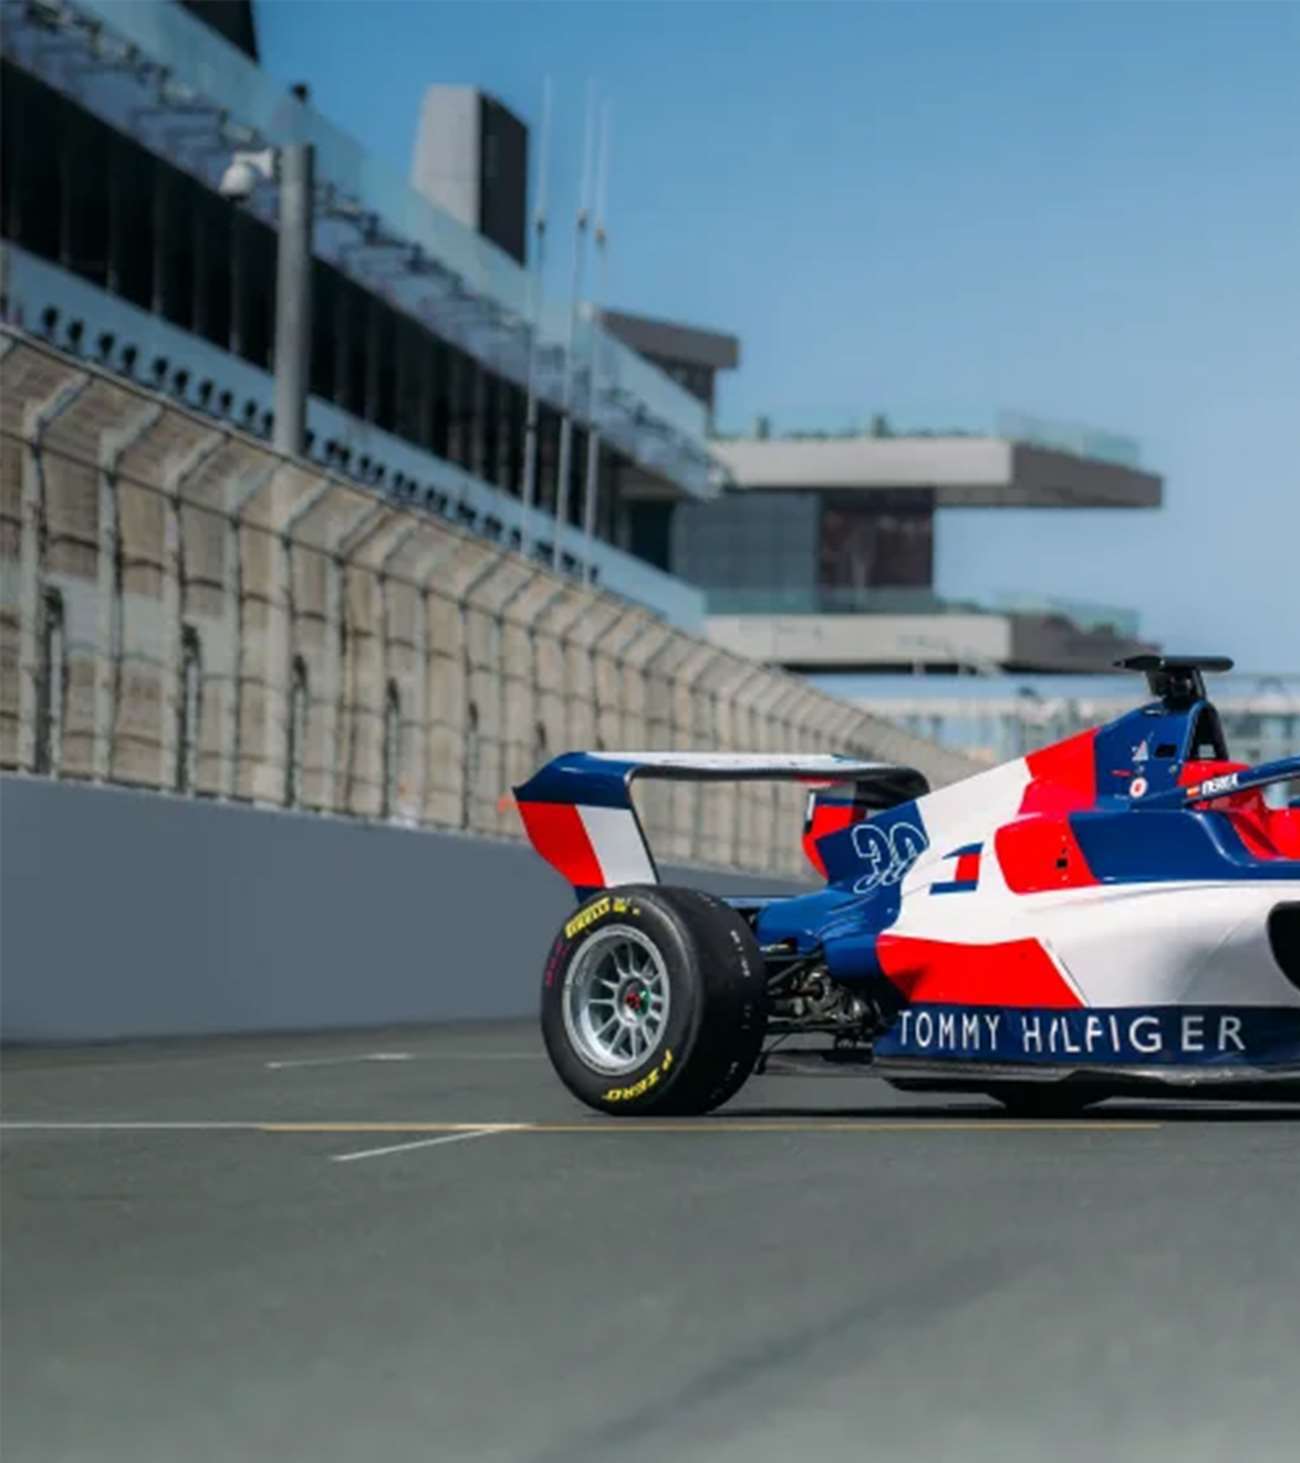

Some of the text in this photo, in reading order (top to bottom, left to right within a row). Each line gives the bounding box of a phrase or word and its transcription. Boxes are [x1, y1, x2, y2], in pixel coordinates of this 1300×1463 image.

[851, 822, 928, 894] 30
[899, 1010, 1246, 1053] TOMMY HILFIGER
